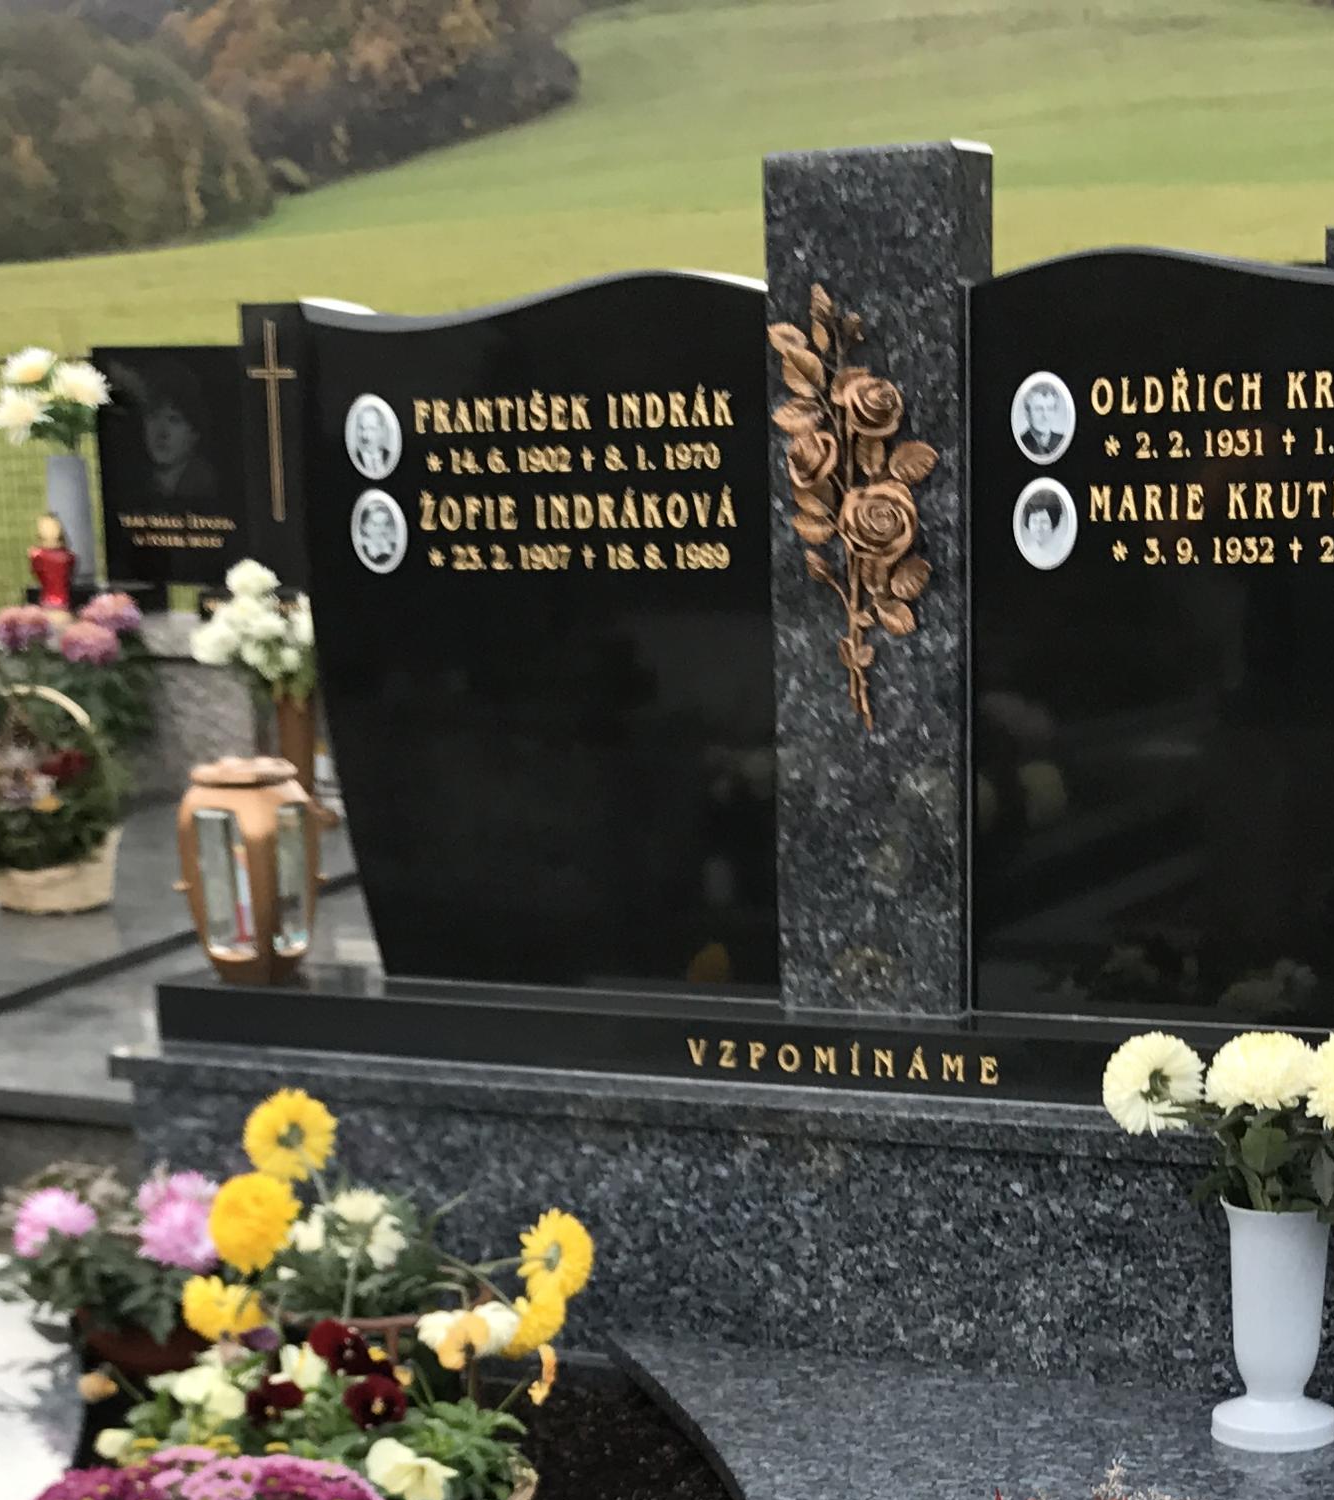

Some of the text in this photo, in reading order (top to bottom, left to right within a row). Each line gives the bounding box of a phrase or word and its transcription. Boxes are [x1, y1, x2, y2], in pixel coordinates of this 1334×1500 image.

[413, 382, 734, 434] FRANTIŠEK INDRÁK
[1090, 367, 1263, 416] OLDŘICH
[450, 441, 721, 474] 14. 6. 1902 8. 1. 1970
[1135, 431, 1159, 459] 2.
[1168, 430, 1192, 458] 2.
[1204, 428, 1265, 457] 1931
[1314, 425, 1334, 455] 1.
[419, 481, 738, 531] ŽOFIE INDRÁKOVÁ
[1089, 481, 1206, 522] MARIE
[489, 543, 515, 571] 2.
[517, 543, 572, 571] 1907
[1143, 537, 1167, 565] 3.
[1175, 536, 1200, 565] 9.
[1212, 536, 1275, 564] 1932
[686, 1037, 1000, 1085] VZPOMÍNÁME
